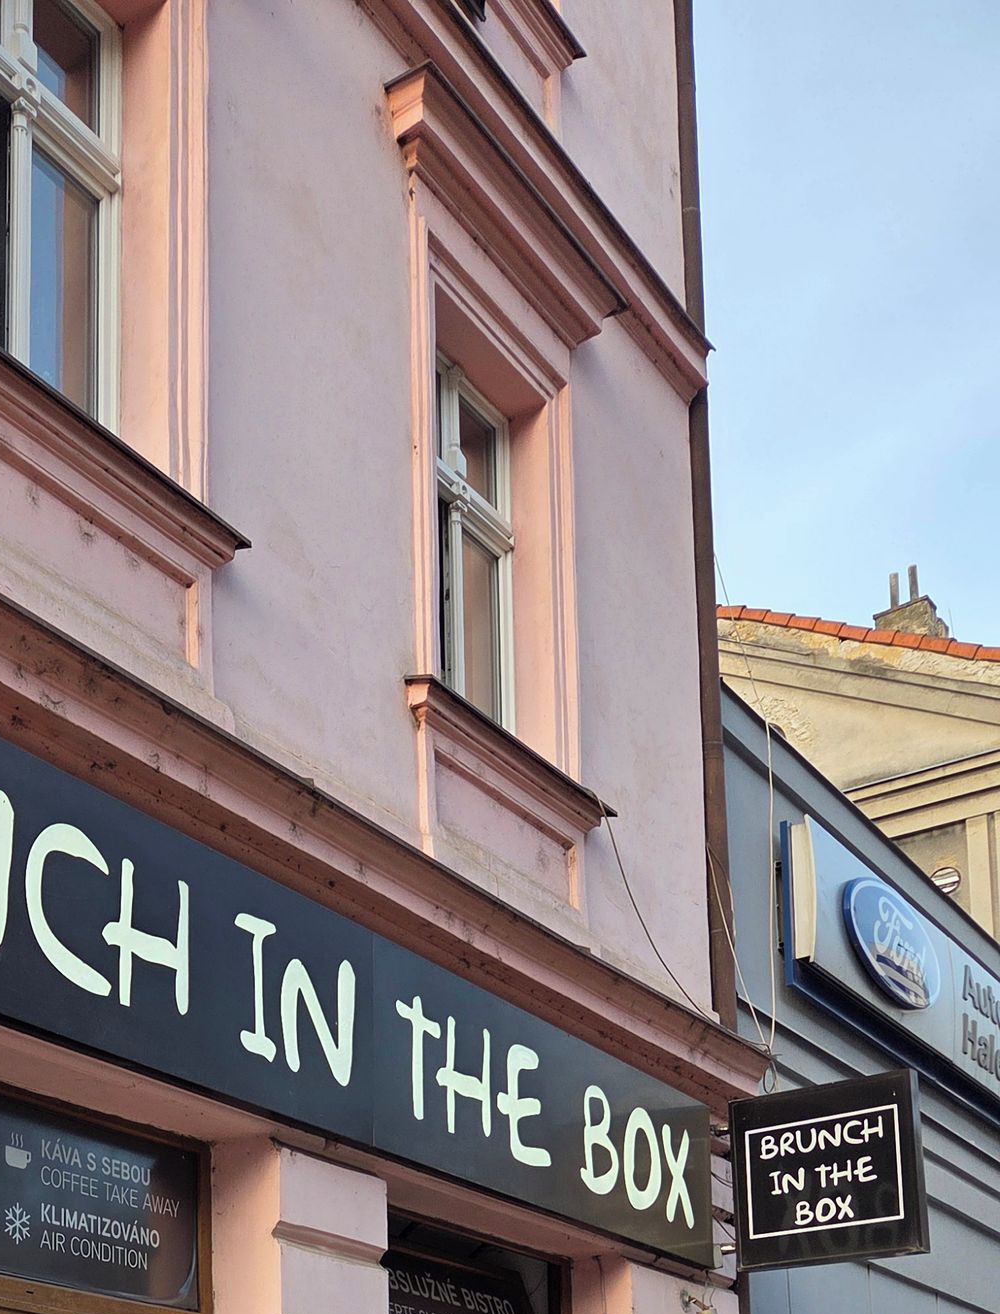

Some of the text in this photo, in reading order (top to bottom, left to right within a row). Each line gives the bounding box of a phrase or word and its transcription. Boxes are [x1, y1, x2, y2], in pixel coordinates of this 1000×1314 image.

[234, 913, 356, 1087] IN
[396, 996, 552, 1166] THE
[580, 1085, 694, 1229] BOX
[759, 1115, 884, 1160] BRUNCH
[40, 1138, 151, 1186] KÁVA S SEBOU
[769, 1155, 878, 1196] IN THE
[40, 1166, 180, 1218] COFFEE TAKE AWAY
[795, 1194, 855, 1226] BOX
[40, 1202, 160, 1249] KLIMATIZOVÁNO
[40, 1230, 148, 1270] AIR CONDITION
